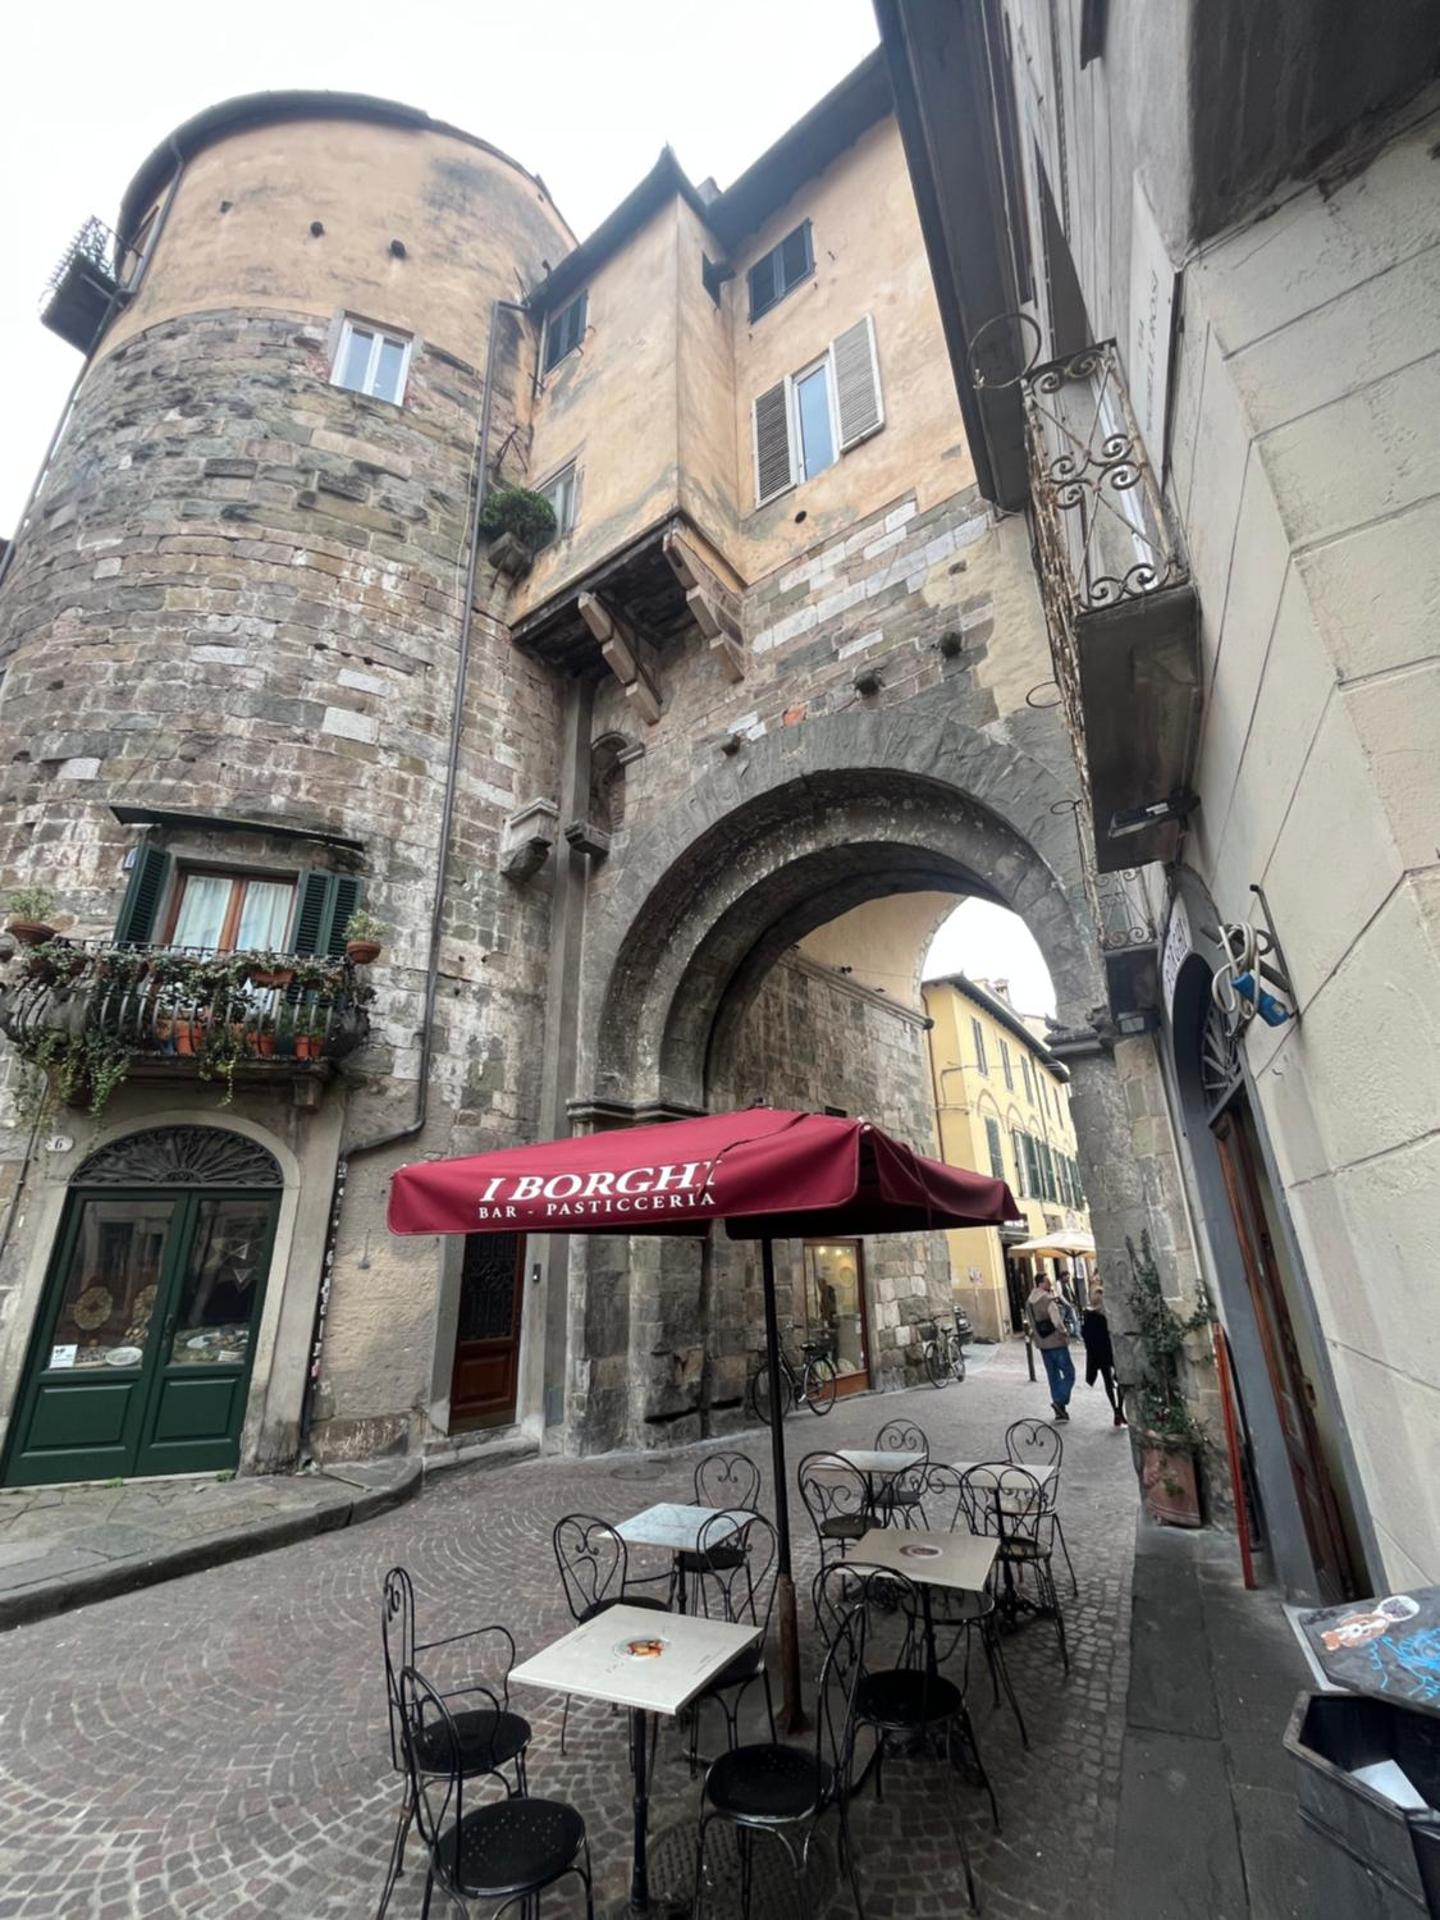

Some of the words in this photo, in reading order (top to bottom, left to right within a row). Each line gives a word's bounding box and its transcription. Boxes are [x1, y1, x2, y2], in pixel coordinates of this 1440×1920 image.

[479, 1177, 506, 1202] I
[507, 1159, 722, 1202] BORGHI
[478, 1205, 517, 1219] BAR
[546, 1191, 716, 1217] PASTICCERIA
